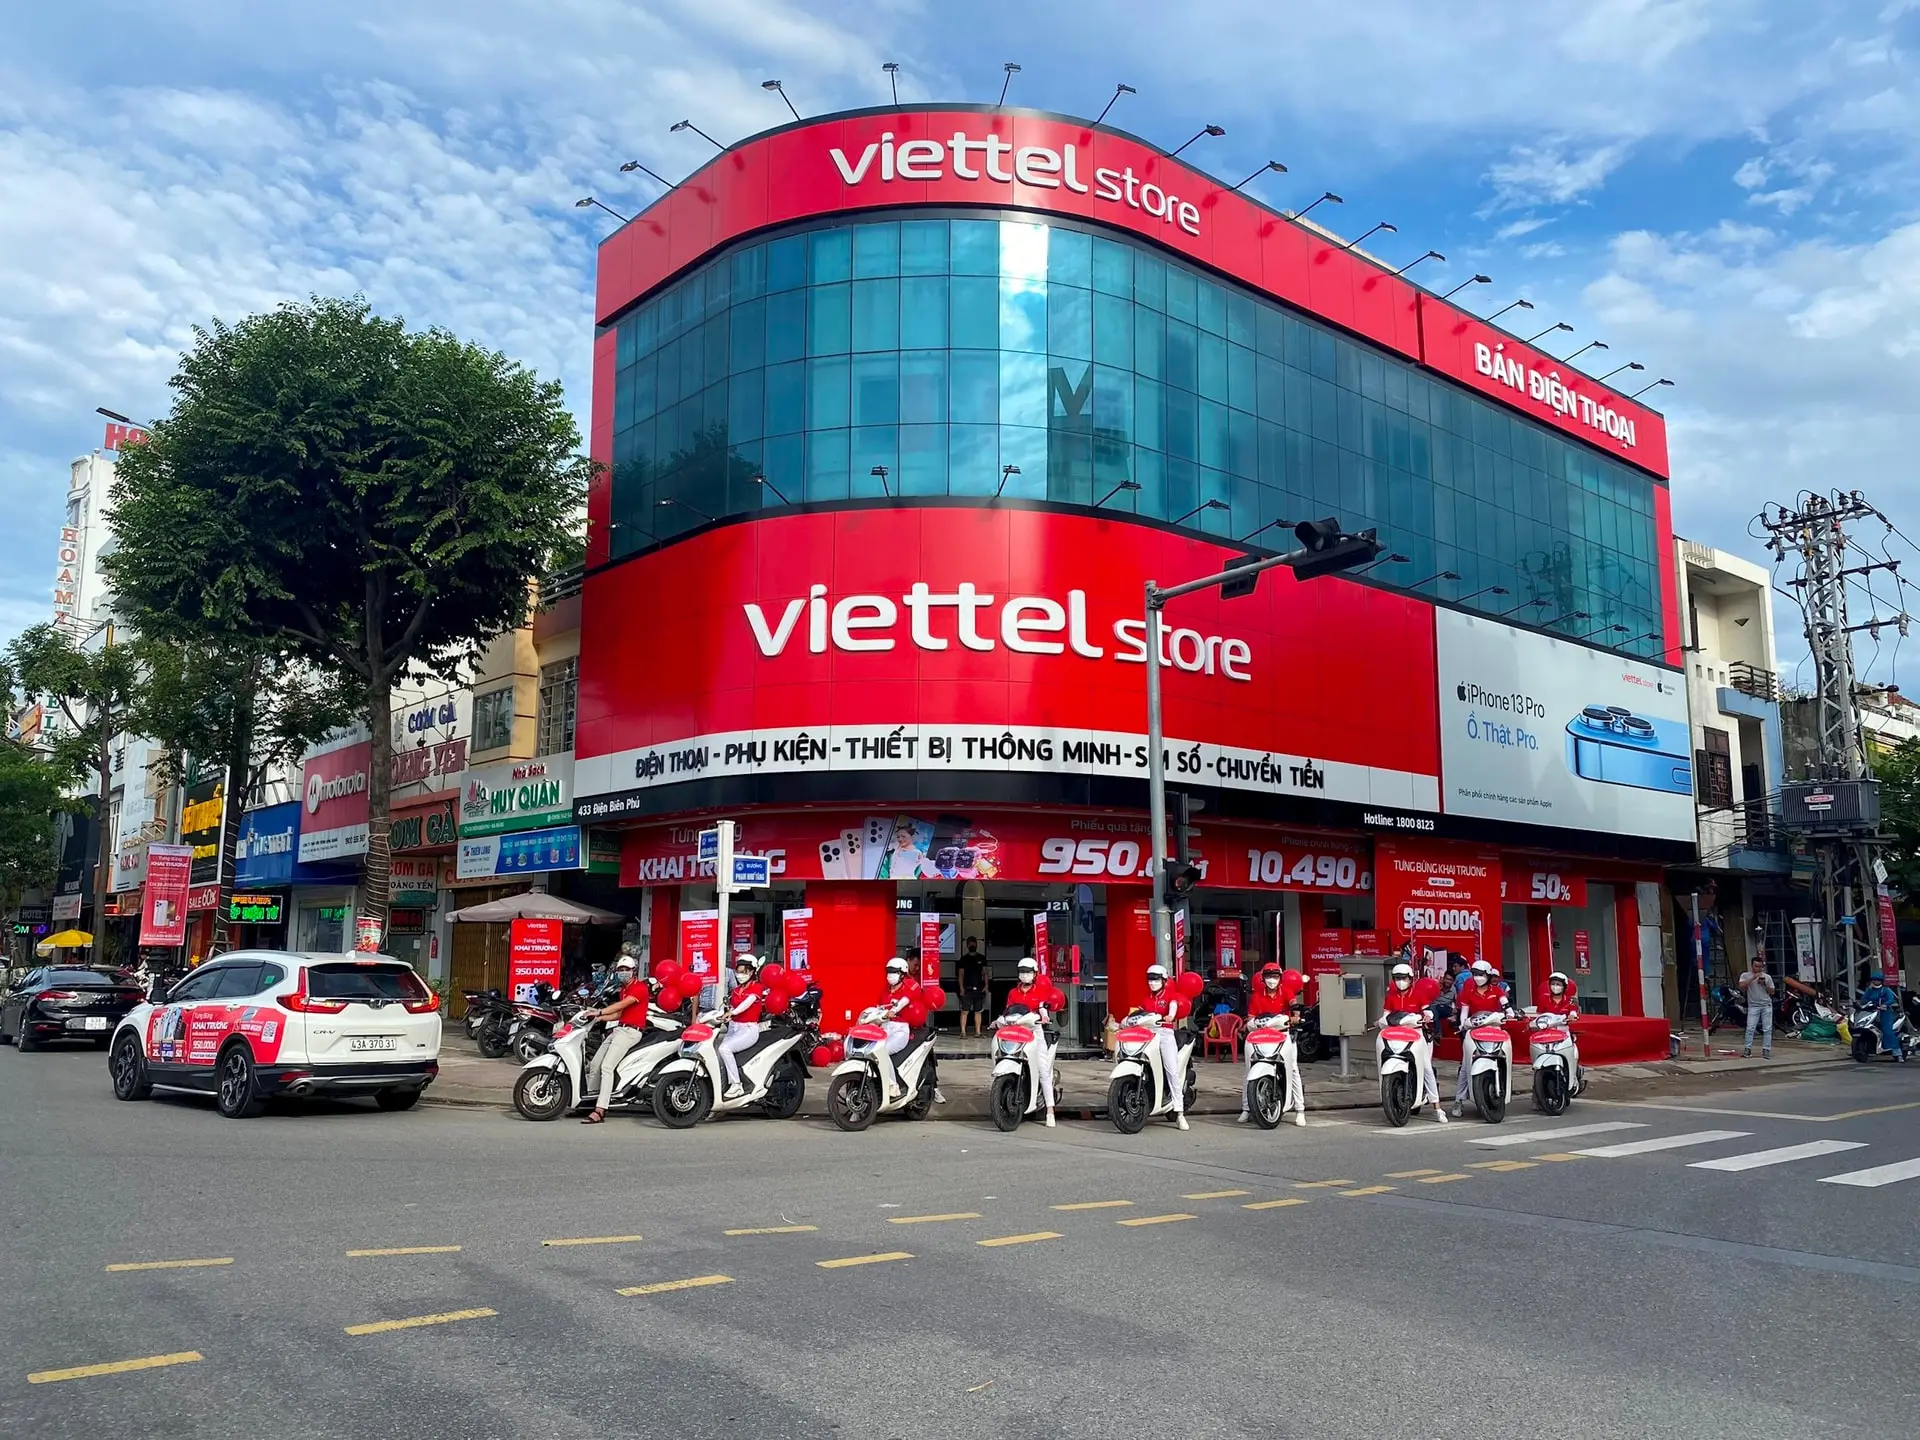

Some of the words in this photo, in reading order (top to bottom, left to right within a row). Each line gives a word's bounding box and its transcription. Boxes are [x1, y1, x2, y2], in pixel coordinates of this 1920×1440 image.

[829, 131, 1089, 195] viettel
[1094, 166, 1201, 236] store
[1474, 342, 1525, 393] BÁN
[1528, 370, 1578, 418] ĐIỆN
[1578, 394, 1637, 449] THOẠI
[743, 582, 1105, 659] viettel
[1113, 611, 1254, 681] store
[1467, 683, 1510, 711] iPhone
[1511, 693, 1524, 714] 13
[1526, 696, 1545, 719] Pro
[1467, 710, 1481, 740] Ồ.
[1482, 721, 1515, 749] Thật.
[1516, 728, 1539, 750] Pro.
[635, 750, 664, 780] ĐIỆN
[668, 746, 709, 772] THOẠI
[725, 740, 767, 767] PHỤ
[773, 732, 828, 765] KIỆN
[844, 726, 919, 760] THIẾT
[928, 736, 951, 764] BỊ
[961, 732, 1053, 762] THÔNG
[1063, 740, 1121, 767] MINH
[1136, 746, 1169, 770] SM
[1177, 742, 1202, 774] SỐ
[1216, 752, 1282, 785] CHUYỂN
[1290, 758, 1324, 789] TIỀN
[320, 770, 366, 802] motorola
[490, 788, 517, 814] HUY
[519, 778, 563, 810] QUÂN
[578, 804, 592, 816] 433
[593, 802, 608, 816] Điện
[609, 799, 625, 812] Biên
[626, 796, 640, 809] Phủ
[1540, 799, 1552, 809] Apple
[1364, 812, 1394, 827] Hotline:
[1396, 816, 1416, 829] 1800
[1416, 818, 1435, 831] 8123
[638, 855, 685, 880] KHAI
[1438, 863, 1456, 875] KHAI
[390, 879, 415, 889] OÀNG
[1531, 872, 1571, 900] 50%
[188, 895, 202, 909] SALE
[202, 888, 217, 906] 60%
[515, 967, 555, 976] 950.000đ
[192, 1021, 207, 1030] KHAI
